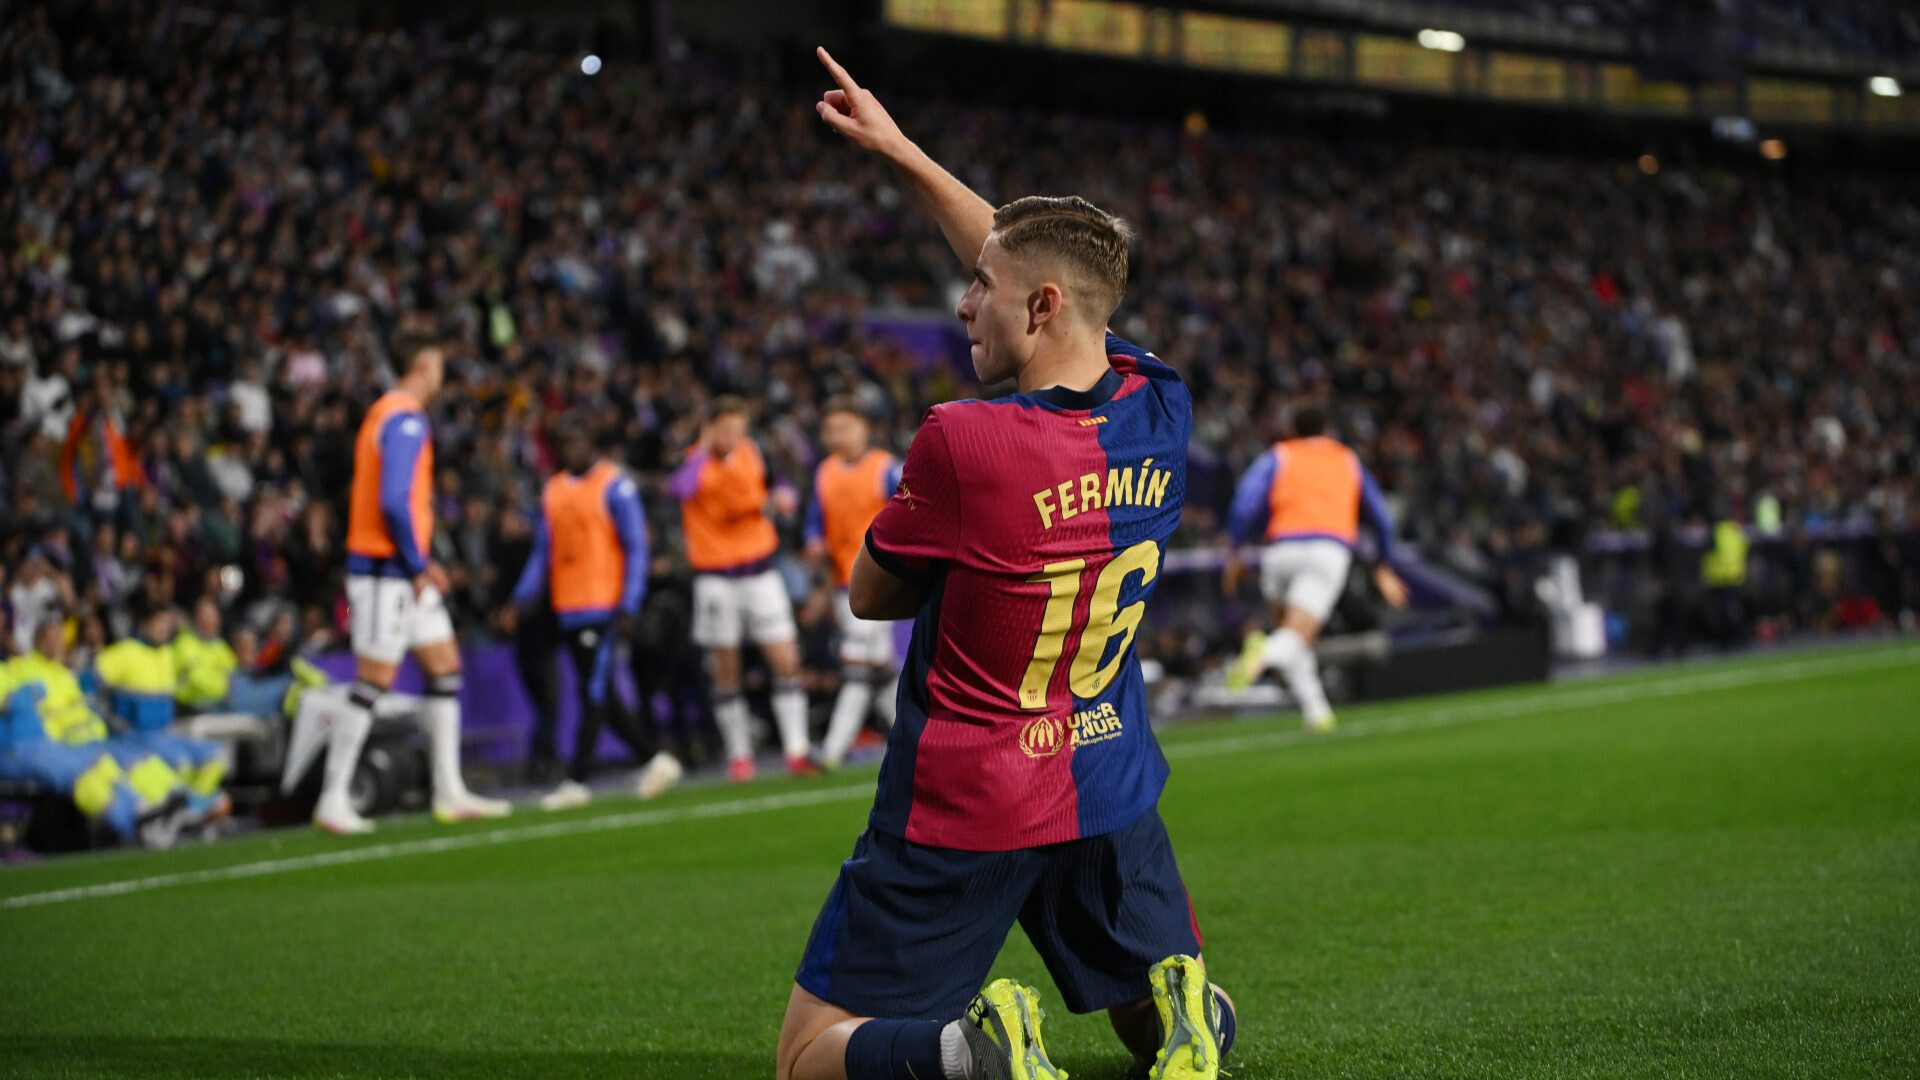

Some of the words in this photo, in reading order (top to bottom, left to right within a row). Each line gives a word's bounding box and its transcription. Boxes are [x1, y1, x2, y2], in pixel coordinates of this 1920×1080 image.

[1032, 458, 1172, 530] FERMÍN
[1017, 539, 1161, 709] 16
[1070, 716, 1123, 746] ANUR
